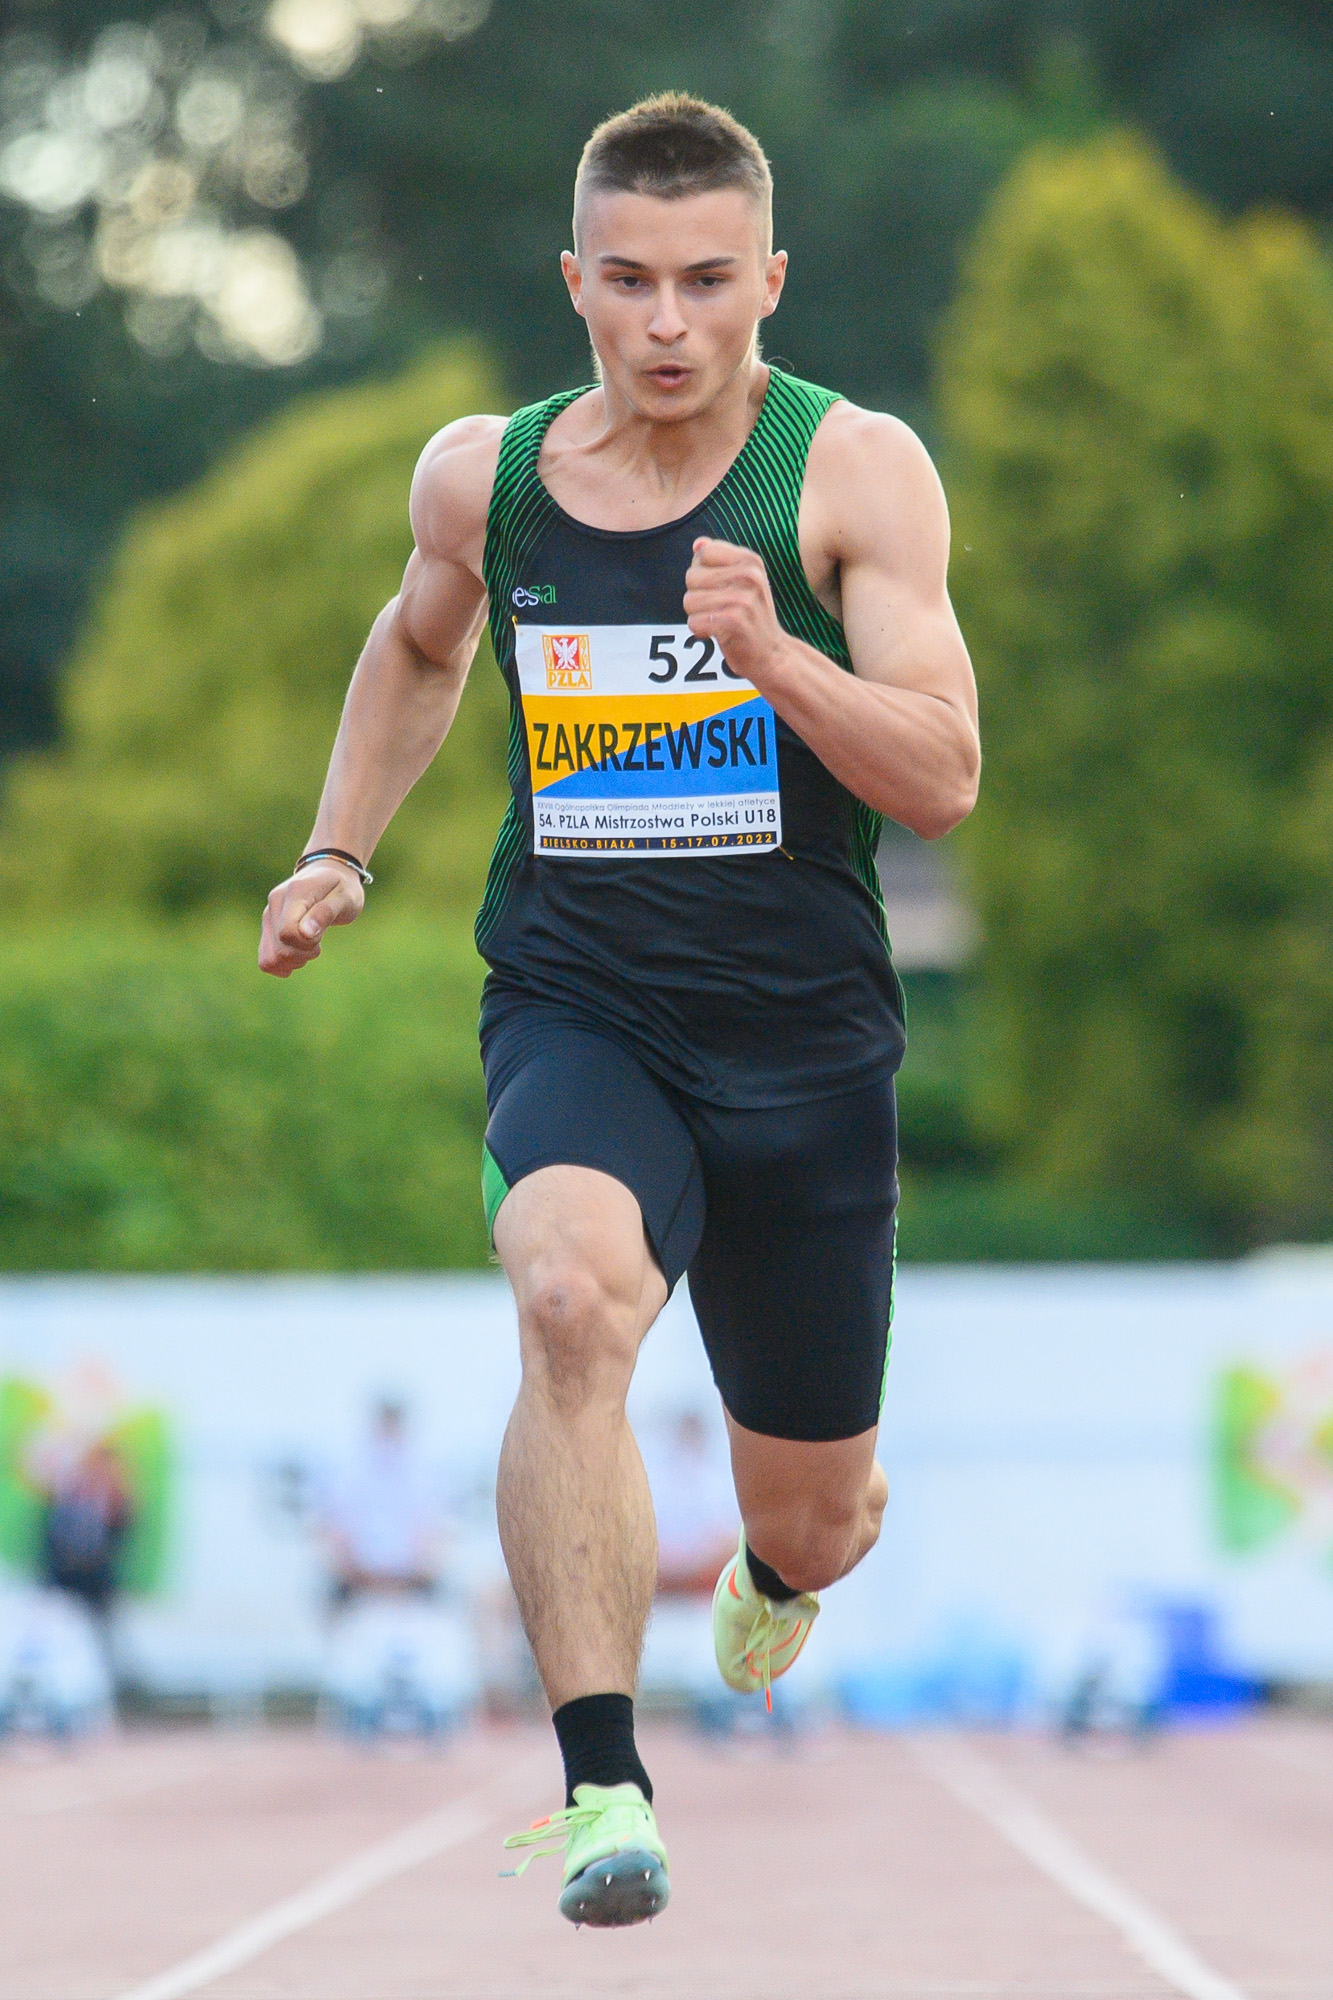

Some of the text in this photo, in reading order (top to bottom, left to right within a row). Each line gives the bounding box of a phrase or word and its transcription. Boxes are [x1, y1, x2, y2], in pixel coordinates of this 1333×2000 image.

[512, 584, 557, 608] esa
[549, 670, 589, 688] PZLA
[533, 716, 768, 772] ZAKRZEWSKI
[555, 803, 605, 812] Ogólnopolska
[607, 803, 649, 812] Olimpiada
[652, 802, 694, 811] Młodzieży
[707, 799, 736, 809] lekkiej
[738, 797, 775, 807] atletyce
[539, 810, 776, 829] 54. PZLA Mistrzostwa Polski U18
[542, 834, 773, 849] BIELSKO-BIAŁA 15-17.07.2022
